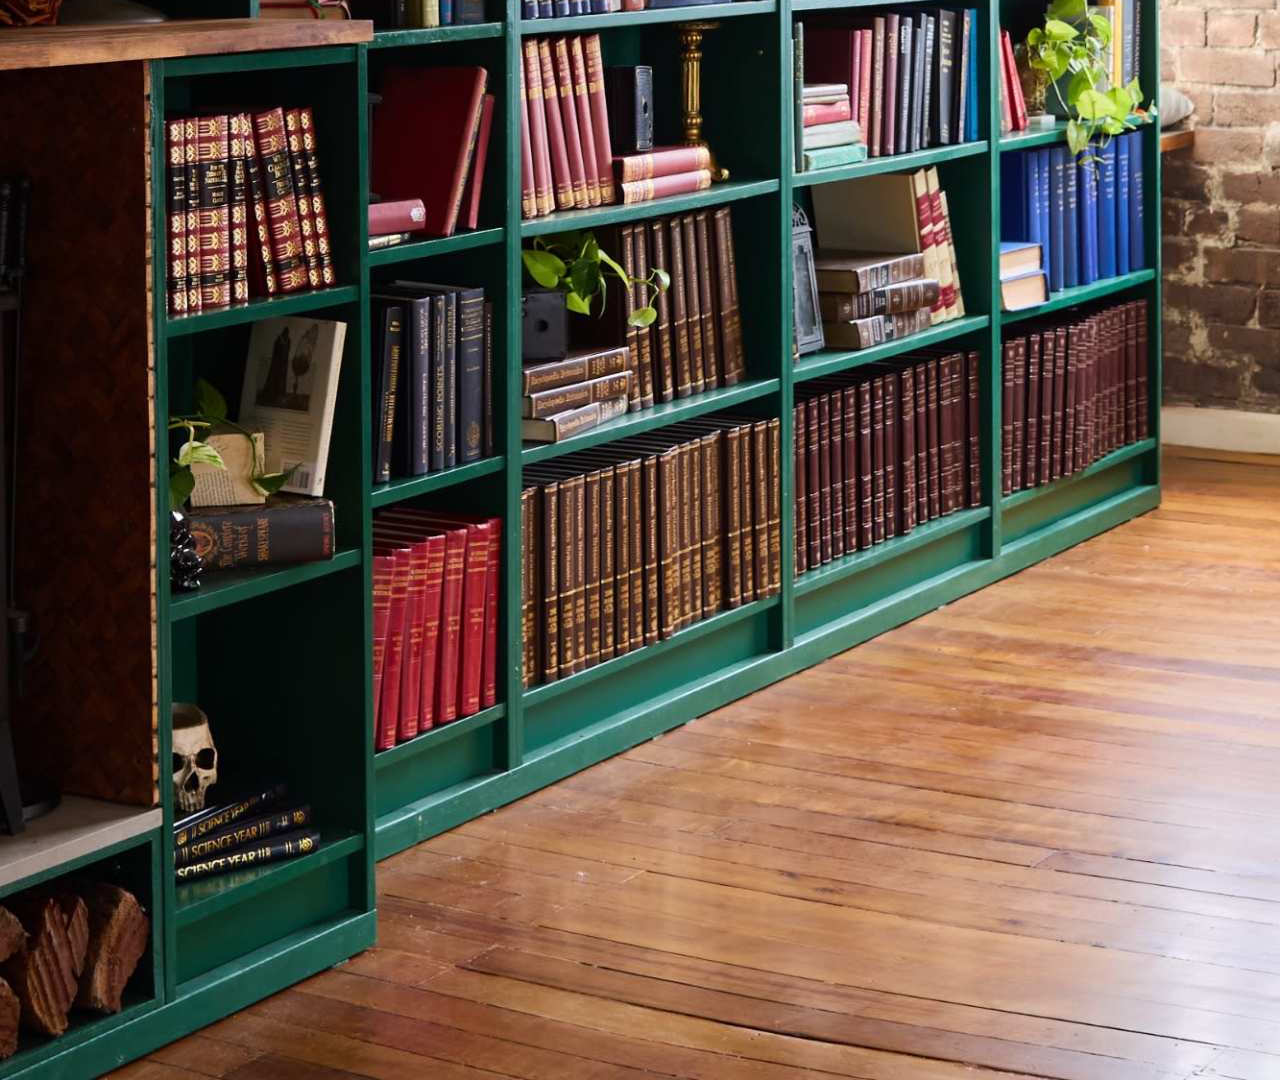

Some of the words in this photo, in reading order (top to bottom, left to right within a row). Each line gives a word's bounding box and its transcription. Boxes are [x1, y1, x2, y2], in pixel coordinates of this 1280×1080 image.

[191, 835, 232, 857] SCIENCE
[233, 826, 257, 846] YEAR
[177, 858, 227, 879] SCIENCE
[228, 851, 257, 867] YEAR
